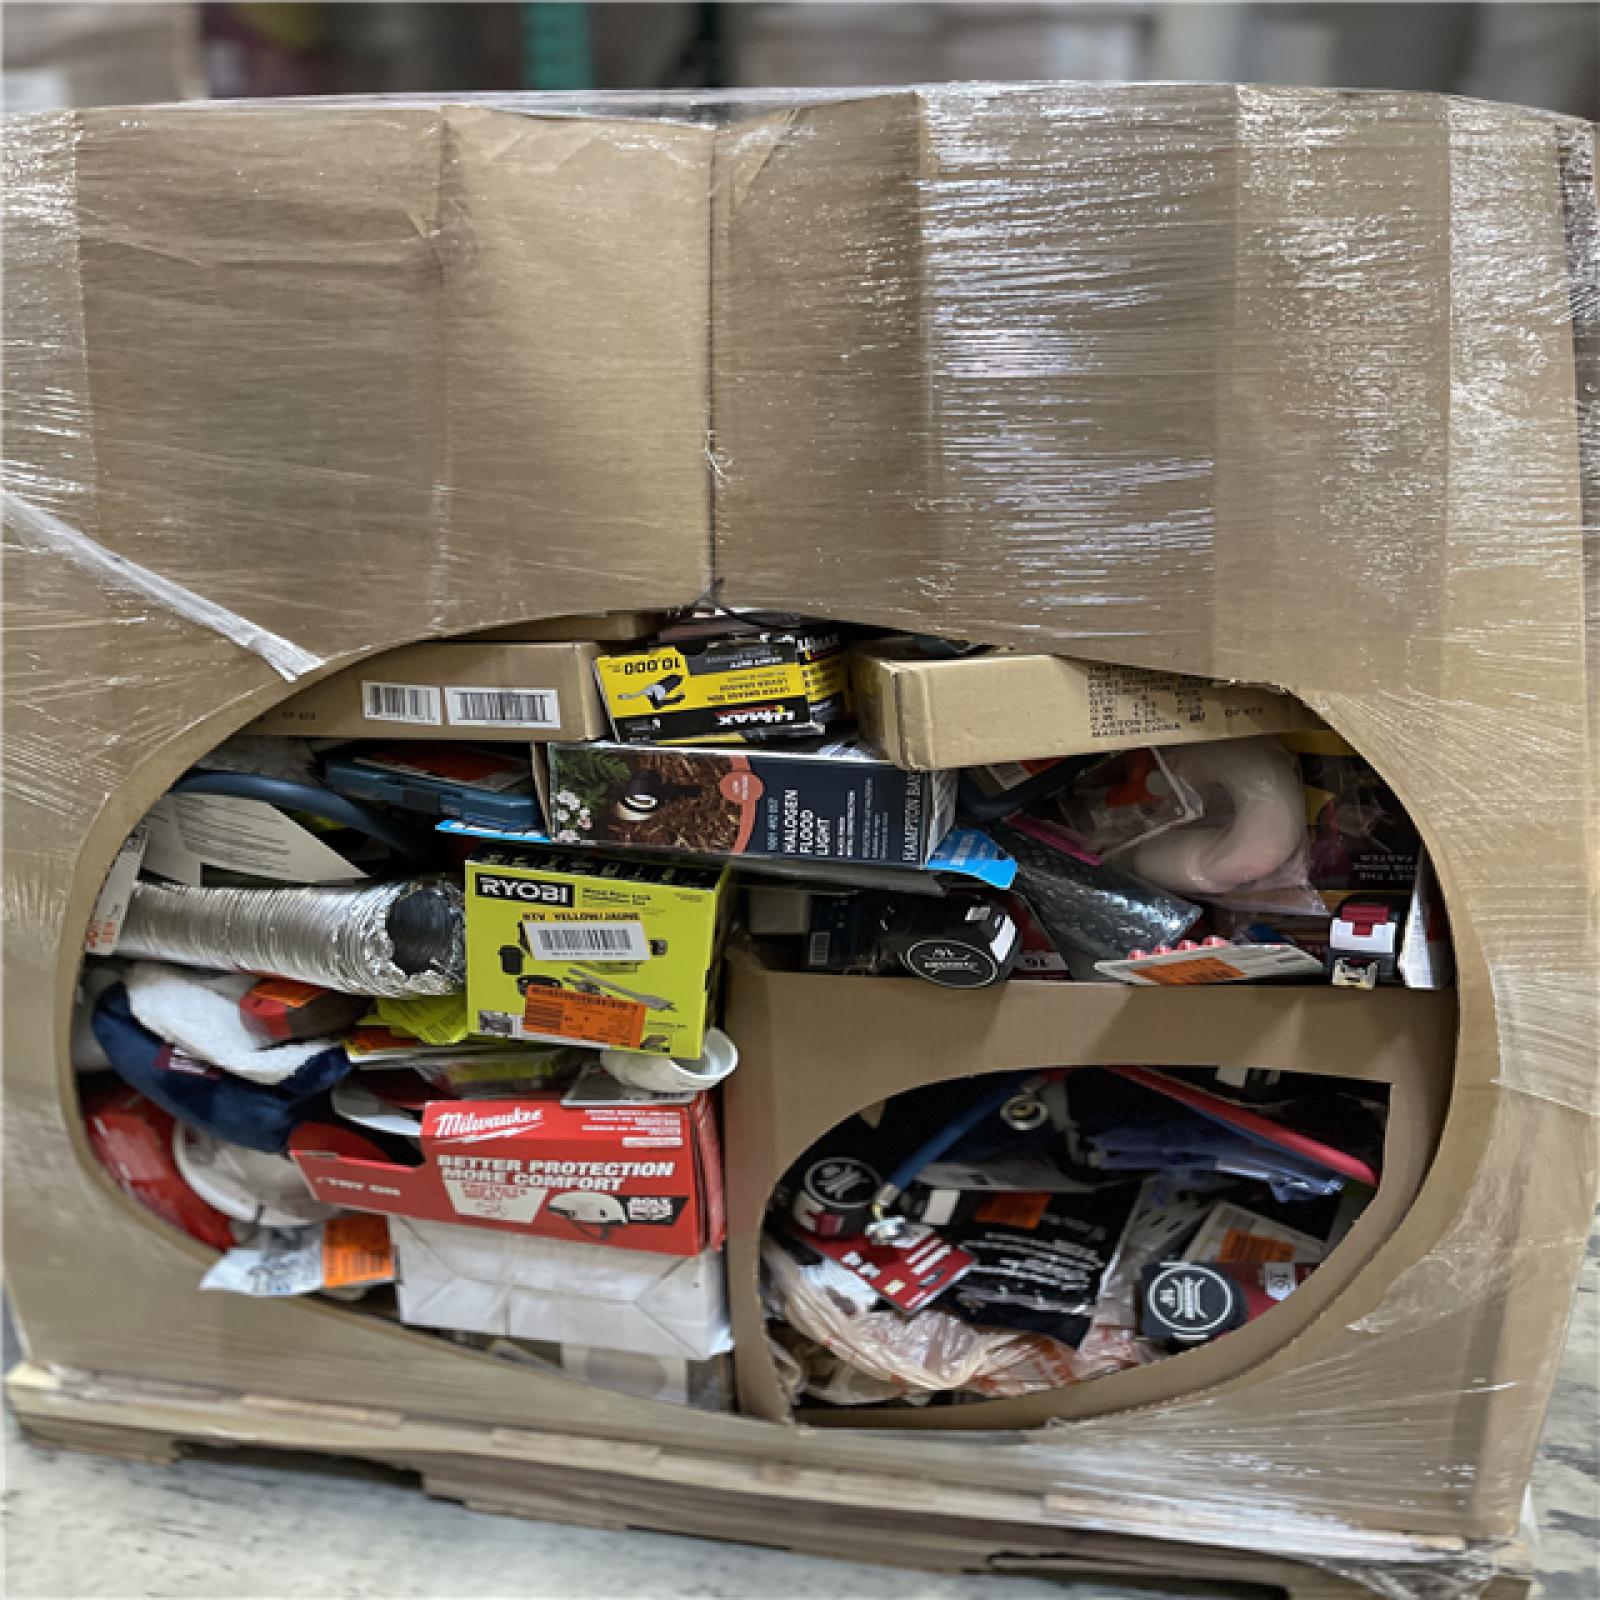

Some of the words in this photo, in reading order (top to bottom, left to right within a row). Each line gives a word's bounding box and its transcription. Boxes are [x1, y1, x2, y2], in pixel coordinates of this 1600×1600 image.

[624, 657, 681, 676] 10,000
[784, 789, 799, 853] HALOGEN
[799, 809, 815, 855] FLOOD
[816, 816, 831, 856] LIGHT
[902, 798, 921, 861] HAMPTON
[479, 876, 570, 903] RYOBI
[432, 1108, 544, 1139] Milwaukee
[436, 1154, 522, 1172] BETTER
[528, 1160, 675, 1177] PROTECTION
[442, 1168, 507, 1183] MORE
[512, 1173, 626, 1192] COMFORT
